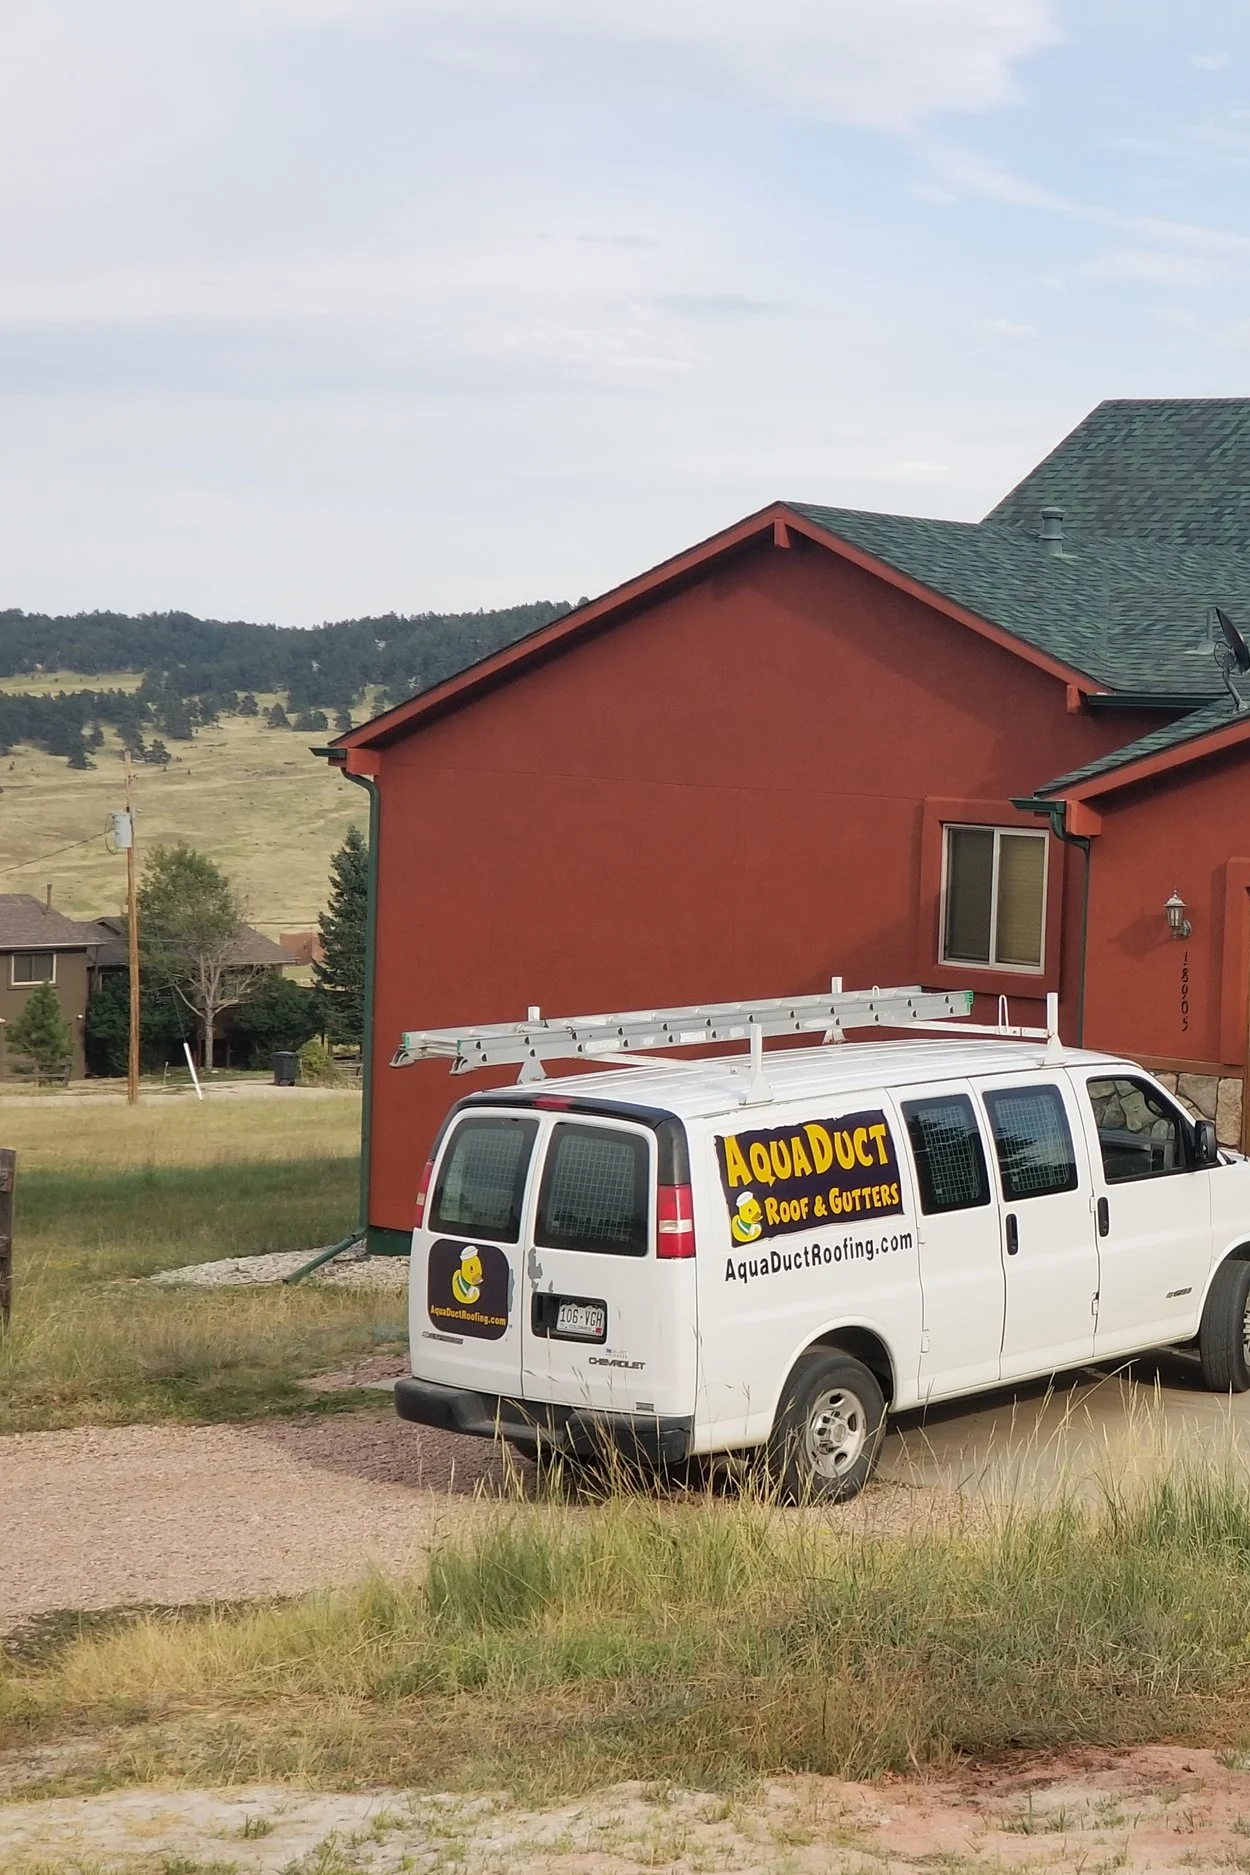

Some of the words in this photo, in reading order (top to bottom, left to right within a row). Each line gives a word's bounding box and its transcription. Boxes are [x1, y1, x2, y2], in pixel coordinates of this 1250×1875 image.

[1181, 951, 1190, 1032] 18905
[723, 1123, 889, 1188] AQUADUCT
[764, 1196, 809, 1226] ROOF
[813, 1195, 828, 1218] &
[828, 1182, 899, 1215] GUTTERS
[725, 1232, 913, 1284] AquaDuctRoofing.com
[430, 1304, 507, 1326] AquaDuctRoofing.com
[588, 1356, 646, 1370] CHEVROLET
